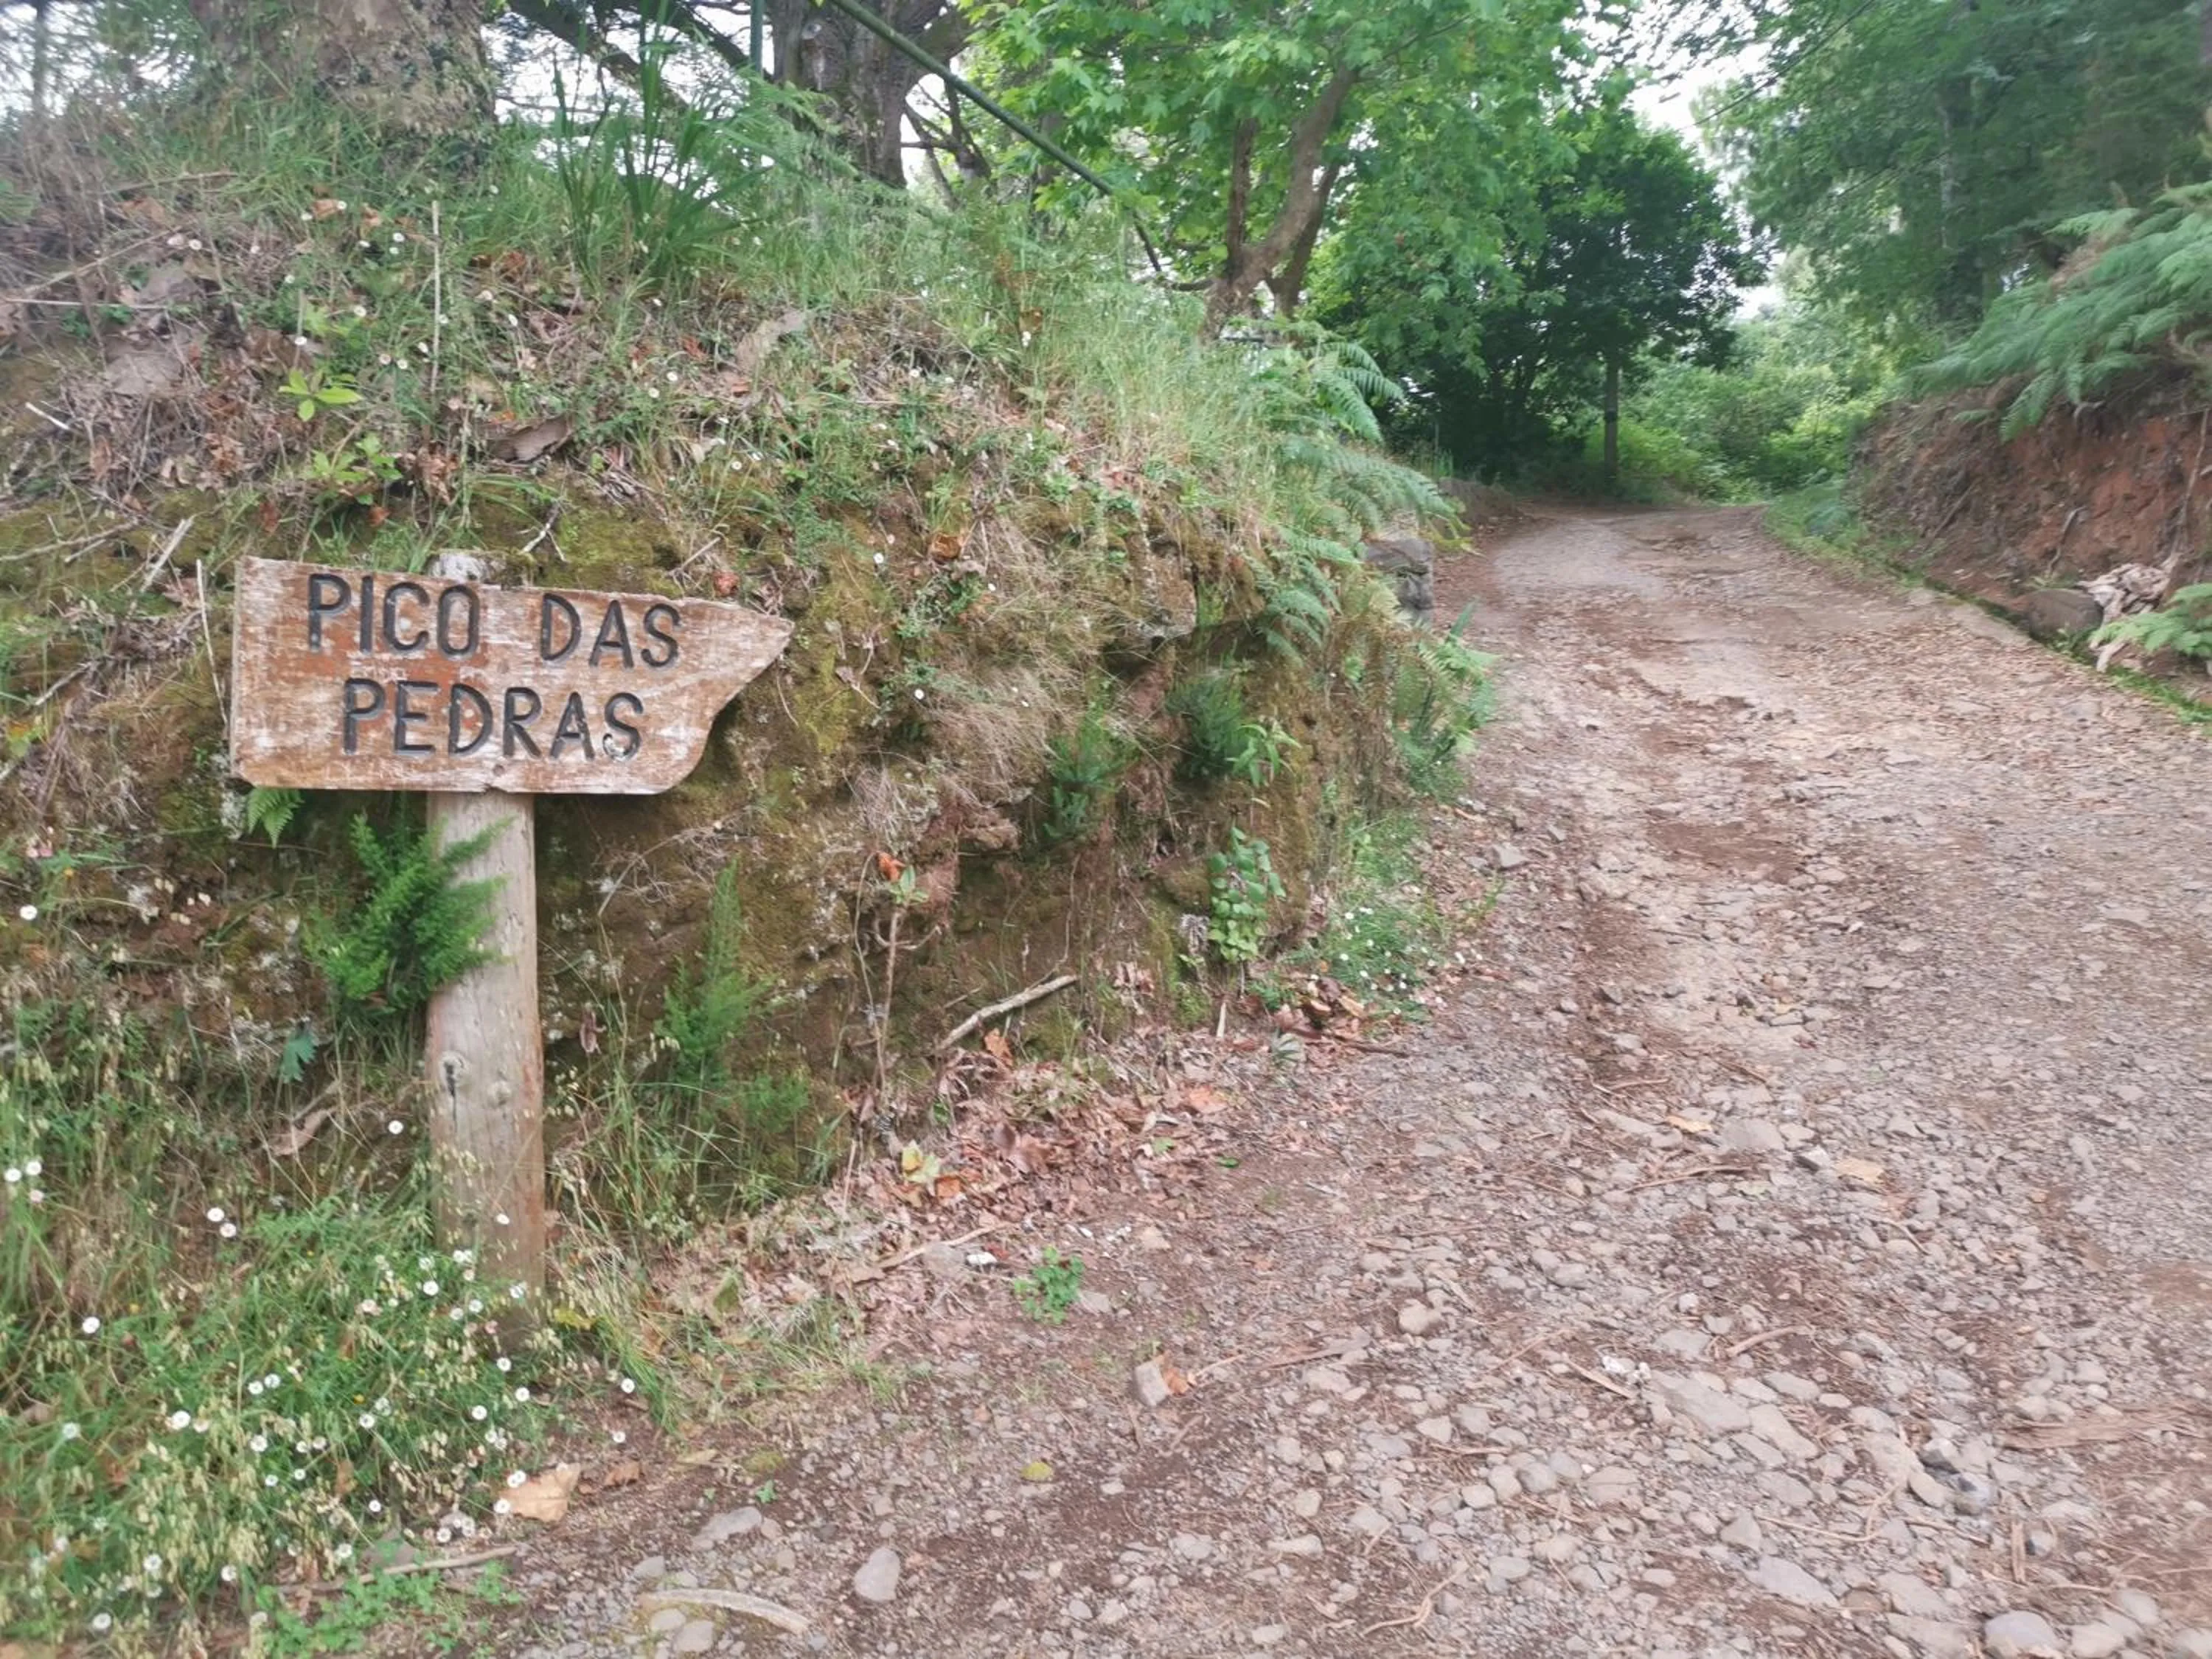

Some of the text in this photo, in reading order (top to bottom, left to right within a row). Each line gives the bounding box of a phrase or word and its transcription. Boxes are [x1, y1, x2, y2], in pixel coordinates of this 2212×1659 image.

[307, 573, 681, 668] PICO DAS
[344, 678, 644, 762] PEDRAS
